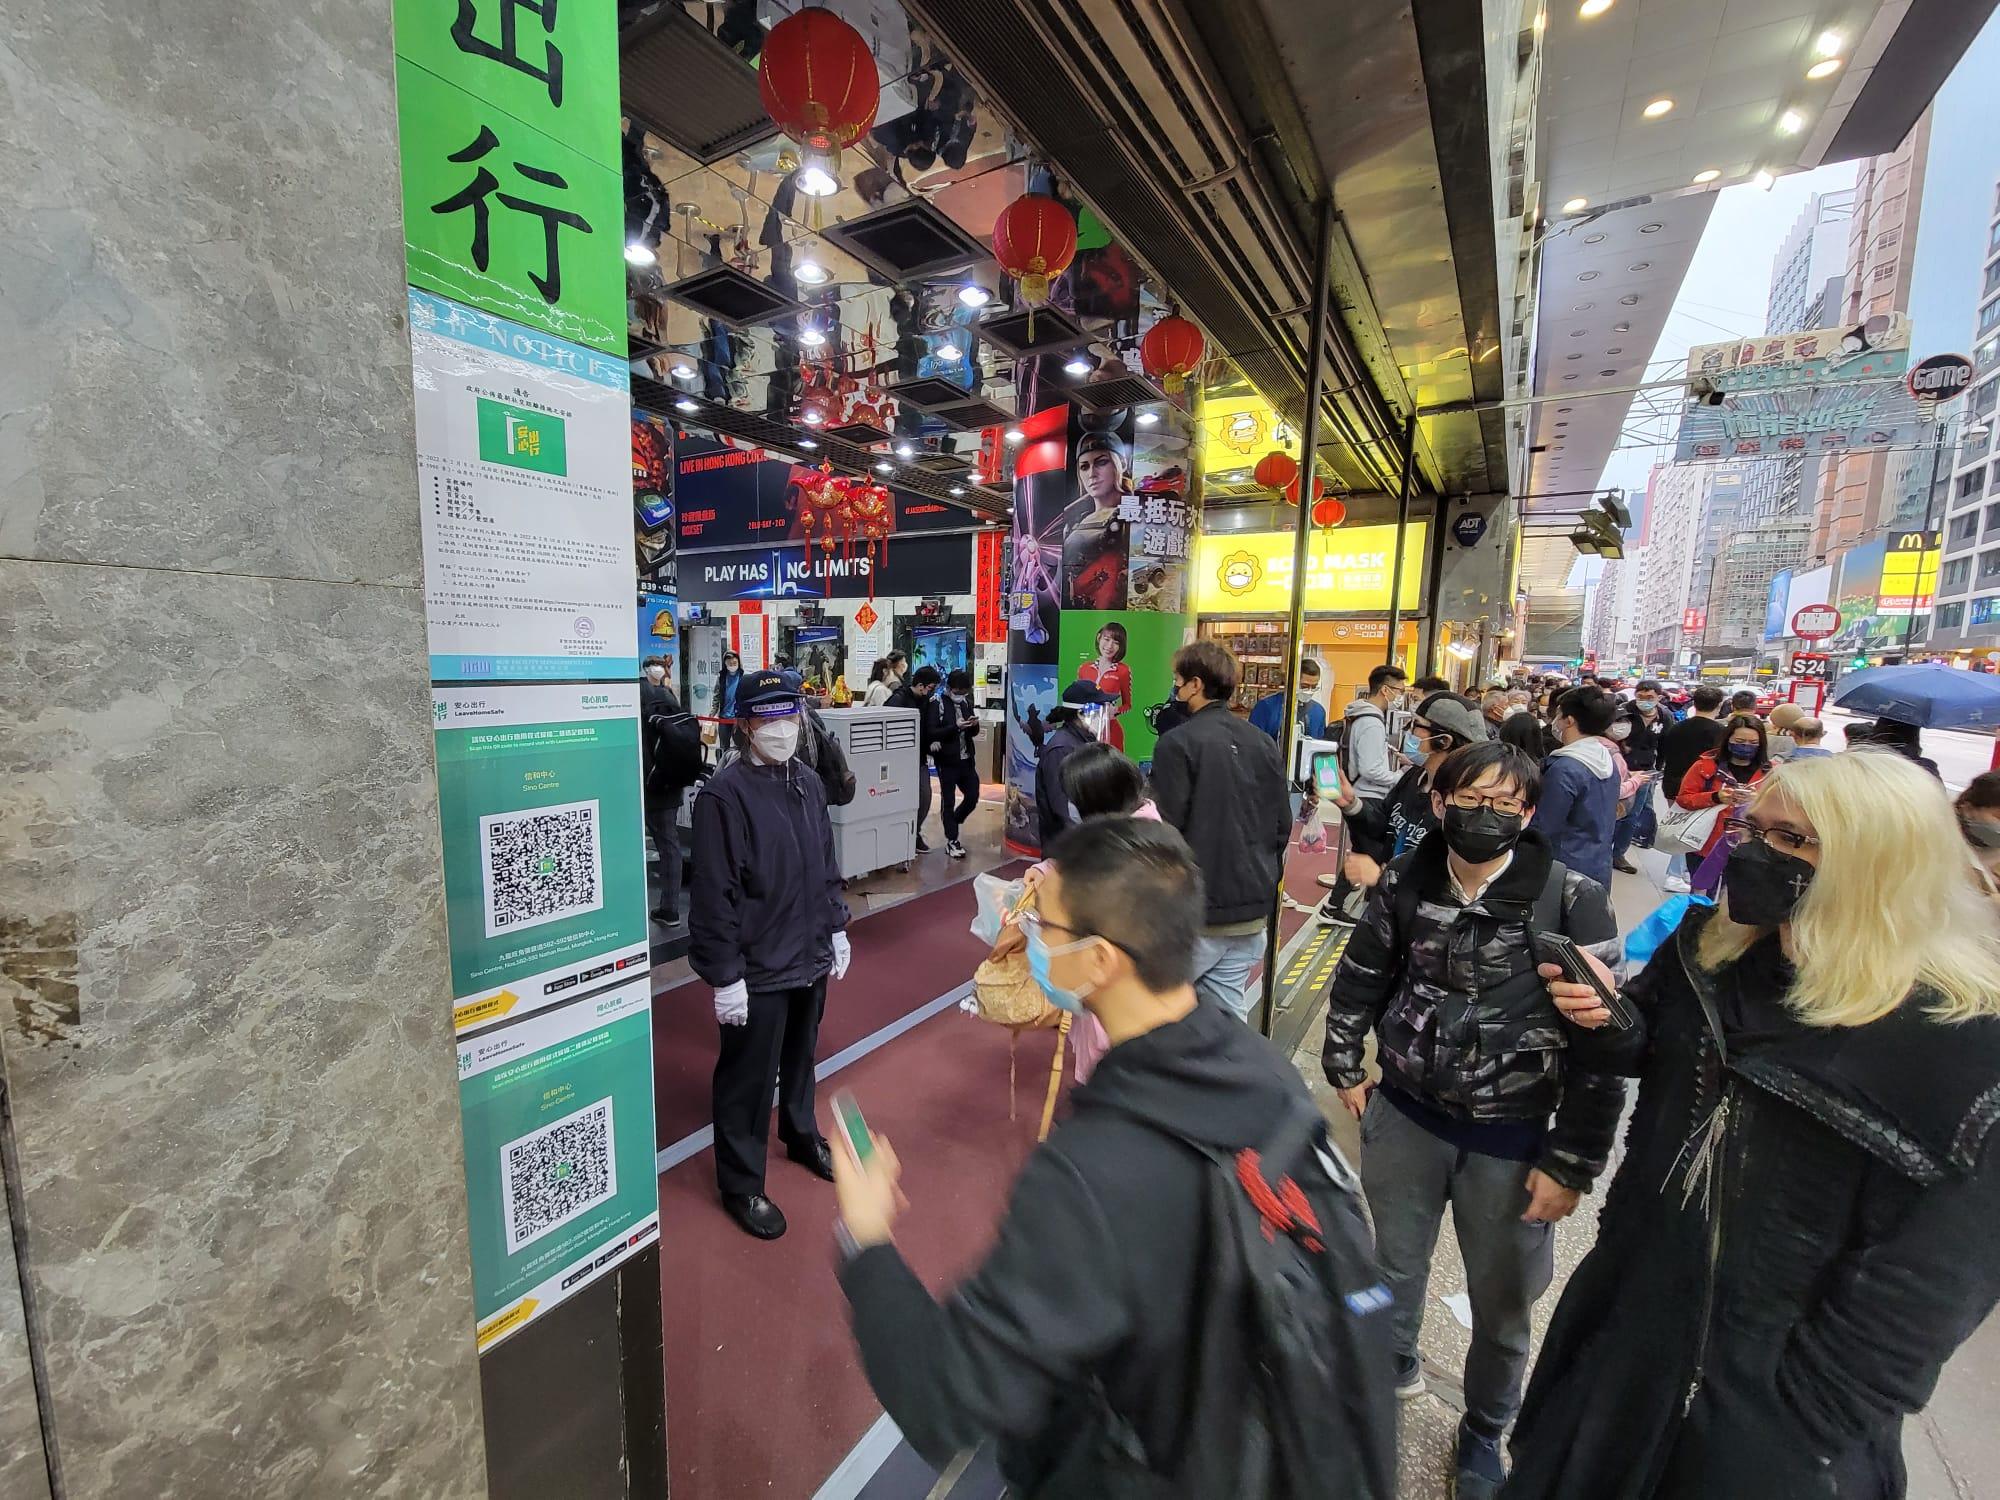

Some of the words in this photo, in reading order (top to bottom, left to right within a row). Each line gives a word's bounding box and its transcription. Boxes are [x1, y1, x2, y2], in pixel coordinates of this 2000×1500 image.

[1459, 517, 1481, 528] ADT
[1324, 552, 1387, 569] MASK
[705, 565, 737, 582] PLAY
[739, 563, 768, 580] HAS
[787, 560, 811, 579] NO
[815, 557, 870, 577] LIMITS
[641, 582, 656, 592] B39
[1793, 660, 1825, 674] S24
[454, 701, 487, 709] 安心出行
[455, 709, 505, 717] LeaveHomeSafe
[524, 770, 556, 781] 信和中心
[522, 783, 537, 792] Sino
[538, 781, 560, 790] Centre
[470, 971, 484, 980] Sino
[553, 982, 564, 990] App
[564, 978, 577, 987] Store
[478, 1039, 508, 1055] 安心出行
